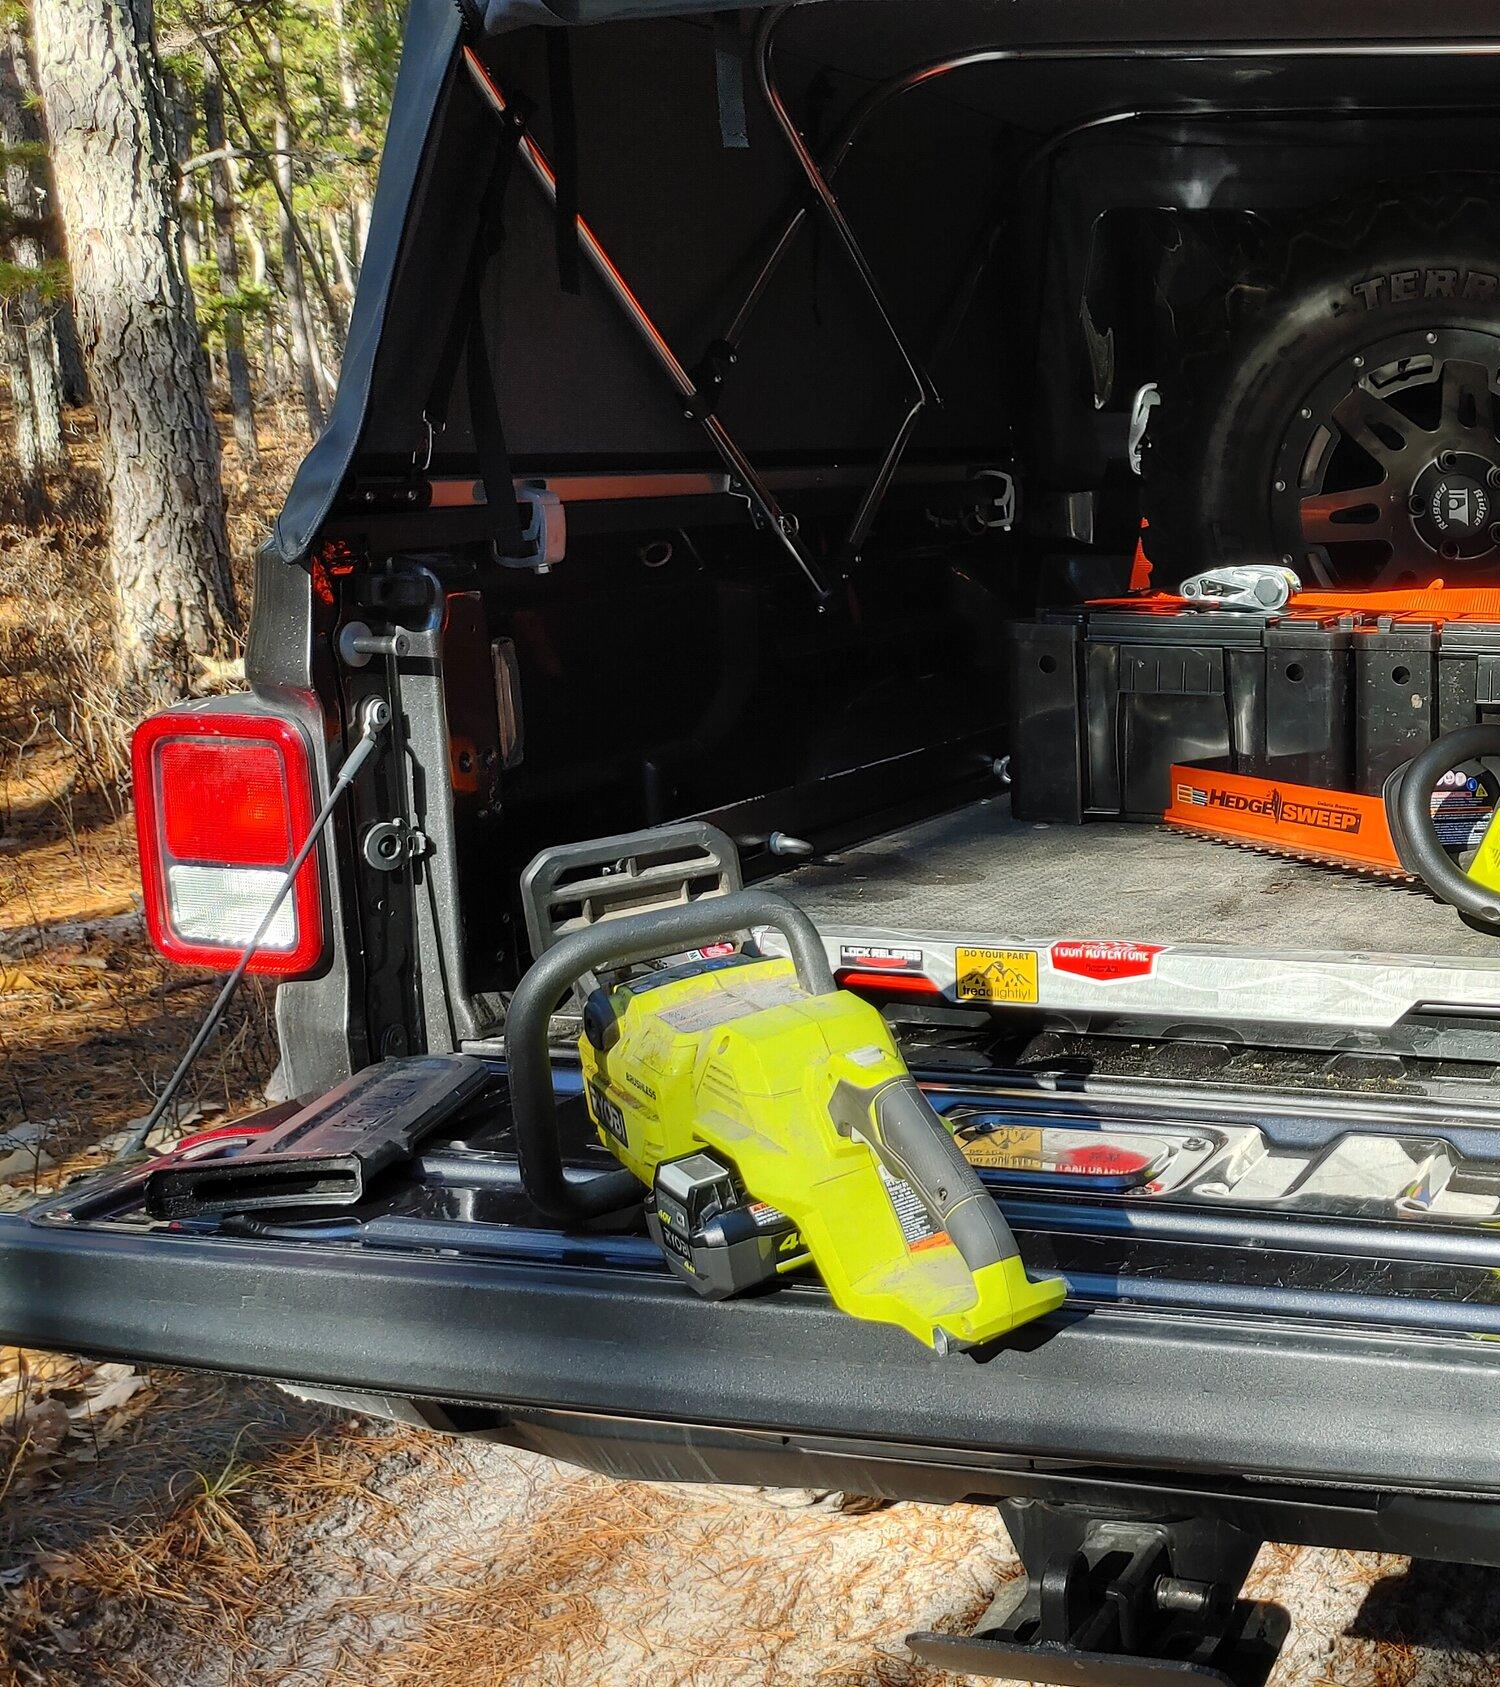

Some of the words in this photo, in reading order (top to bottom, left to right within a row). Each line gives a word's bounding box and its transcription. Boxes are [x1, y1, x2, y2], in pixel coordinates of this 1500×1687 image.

[1433, 482, 1448, 530] Rugged
[1473, 489, 1487, 526] Ridge
[1210, 788, 1273, 816] HEDGE
[1282, 804, 1358, 830] SWEEP
[841, 946, 871, 957] LOCK
[871, 948, 922, 961] RELEASE
[964, 949, 977, 957] DO
[980, 950, 1004, 959] YOUR
[1007, 952, 1030, 960] PART
